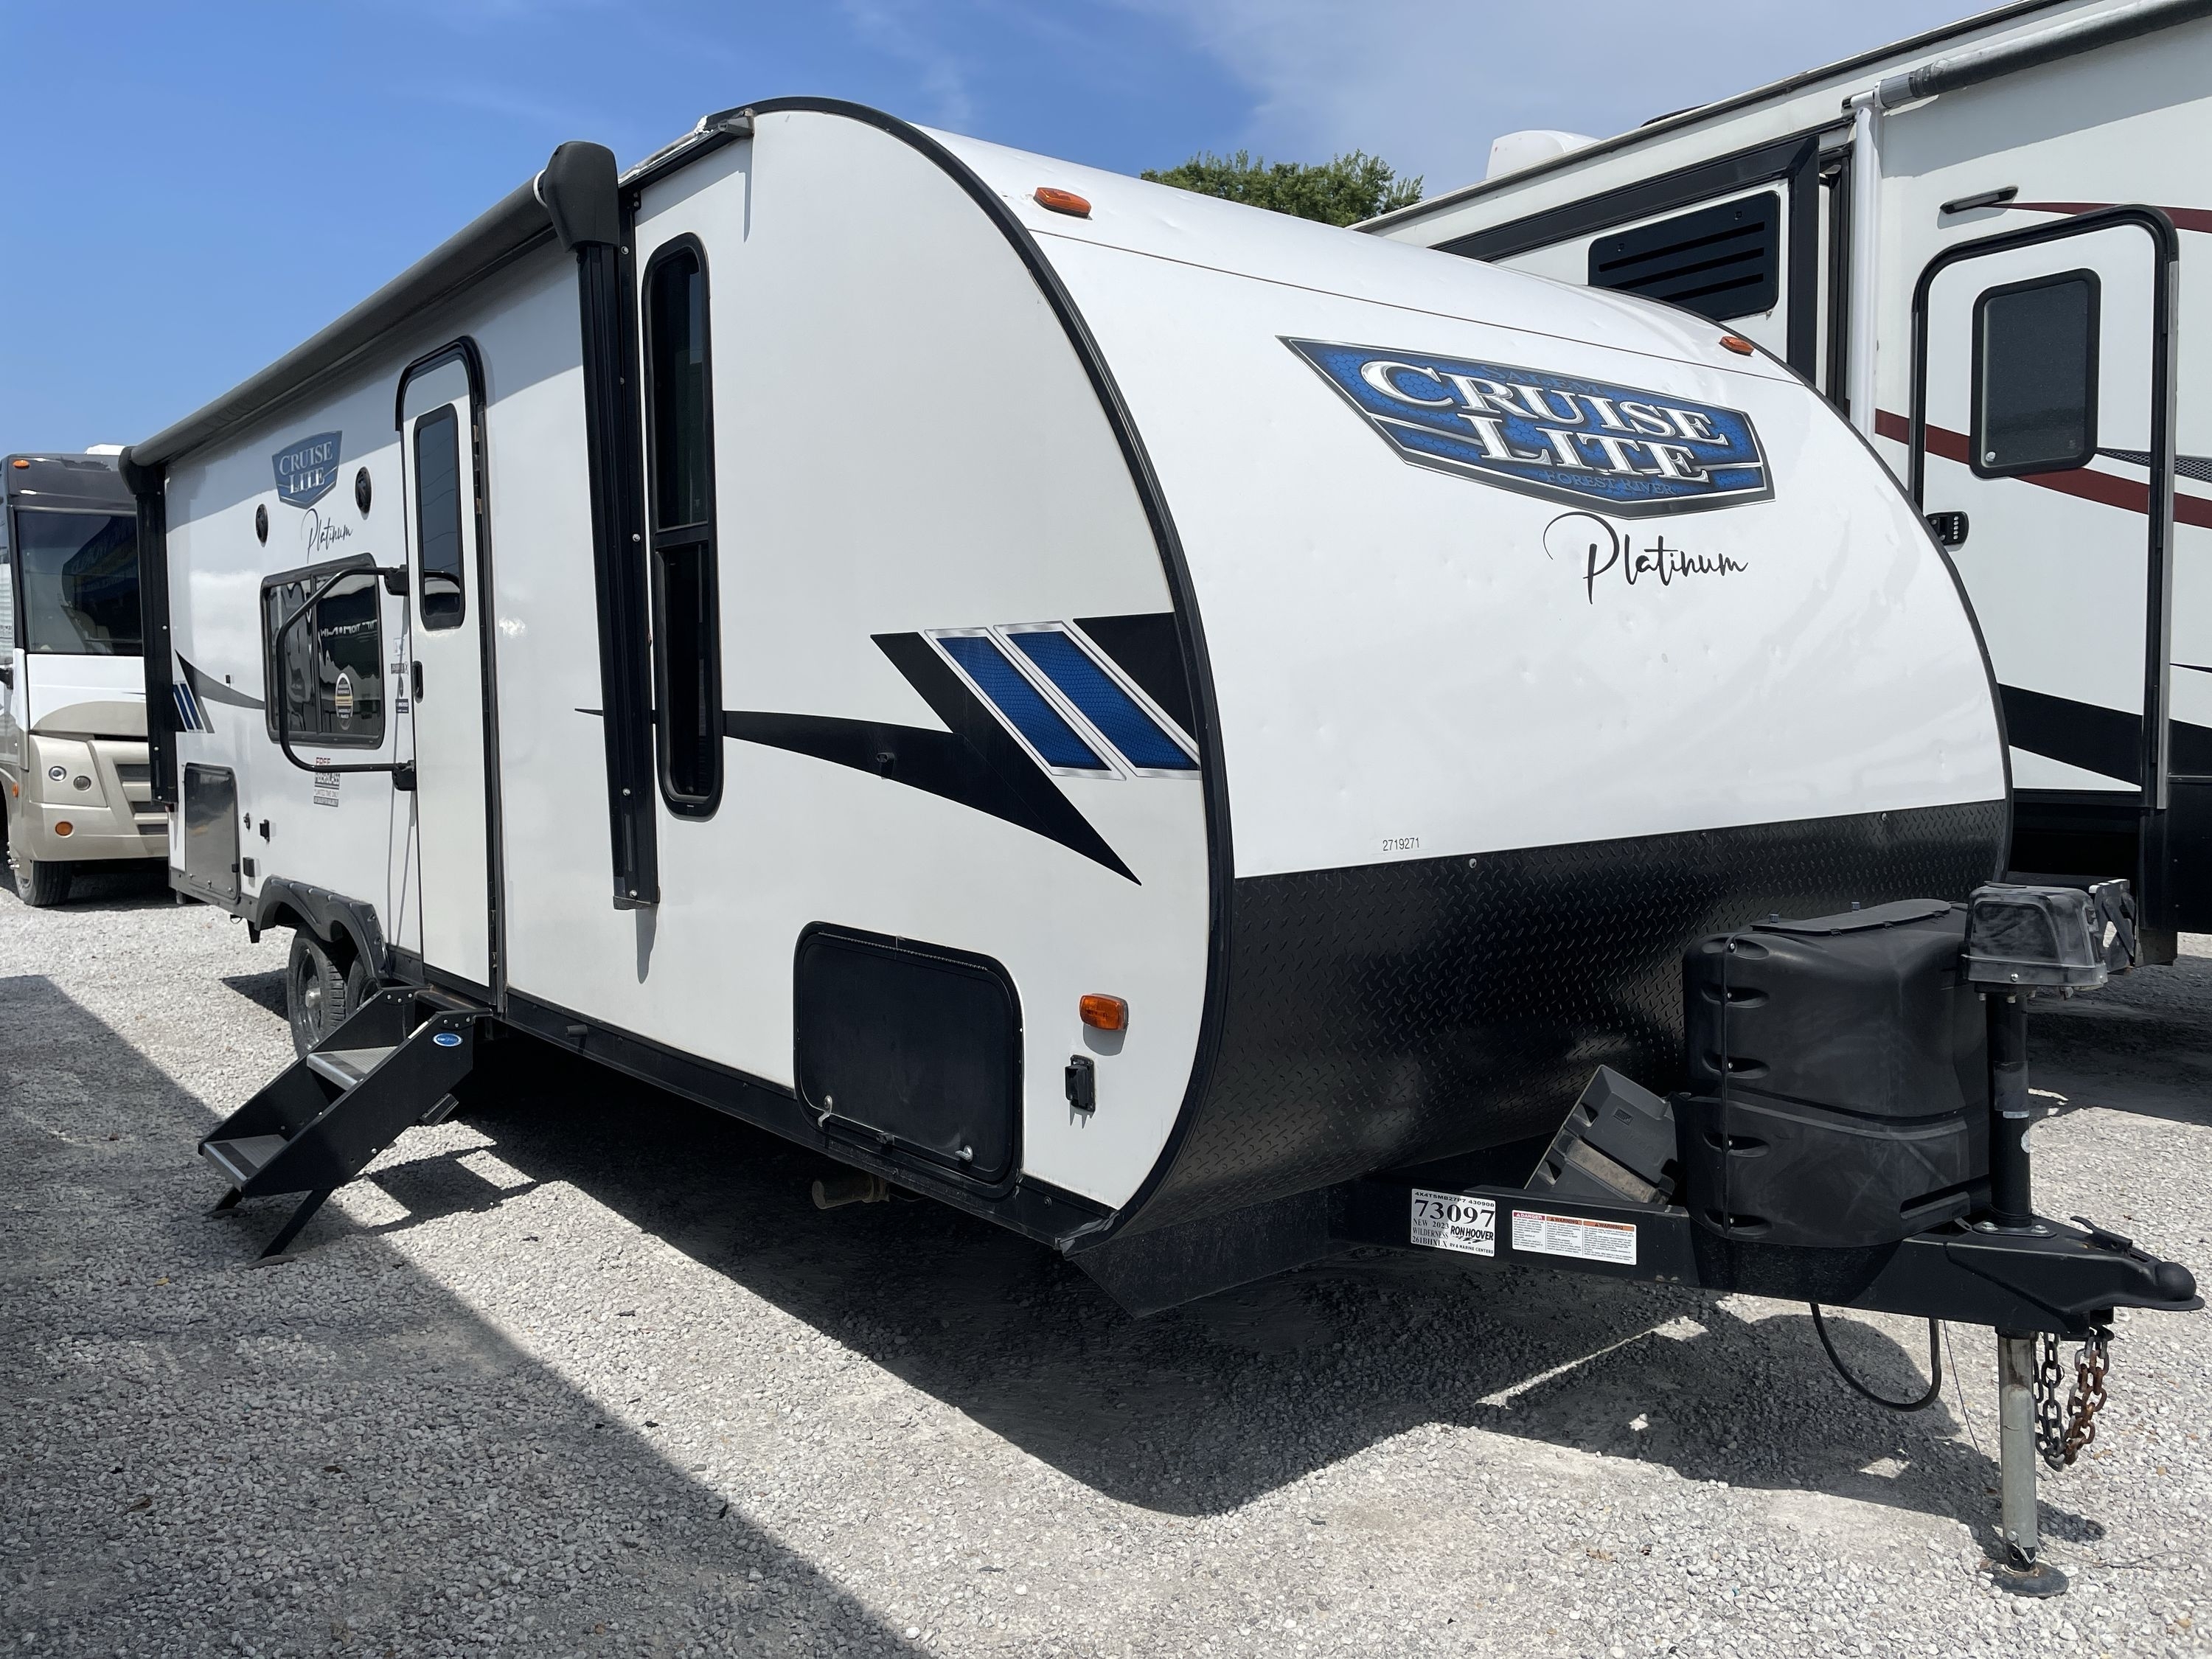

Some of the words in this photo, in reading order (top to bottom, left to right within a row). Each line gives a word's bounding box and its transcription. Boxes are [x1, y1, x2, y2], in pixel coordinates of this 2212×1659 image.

[1481, 365, 1605, 395] SALEM
[1360, 360, 1729, 446] CRUISE
[279, 442, 333, 476] CRUISE
[1458, 413, 1710, 484] LITE
[289, 467, 325, 494] LITE
[1545, 470, 1618, 490] FOREST
[1623, 478, 1677, 495] RIVER
[301, 508, 353, 564] Platinum
[1543, 511, 1748, 605] Platinum
[1382, 838, 1419, 852] 2719271
[1413, 1218, 1428, 1227] NEW
[1432, 1220, 1450, 1229] 2023
[1414, 1199, 1495, 1228] 73097
[1413, 1227, 1449, 1239] WILDERNESS
[1450, 1225, 1465, 1237] RON
[1465, 1227, 1494, 1241] HOOVER
